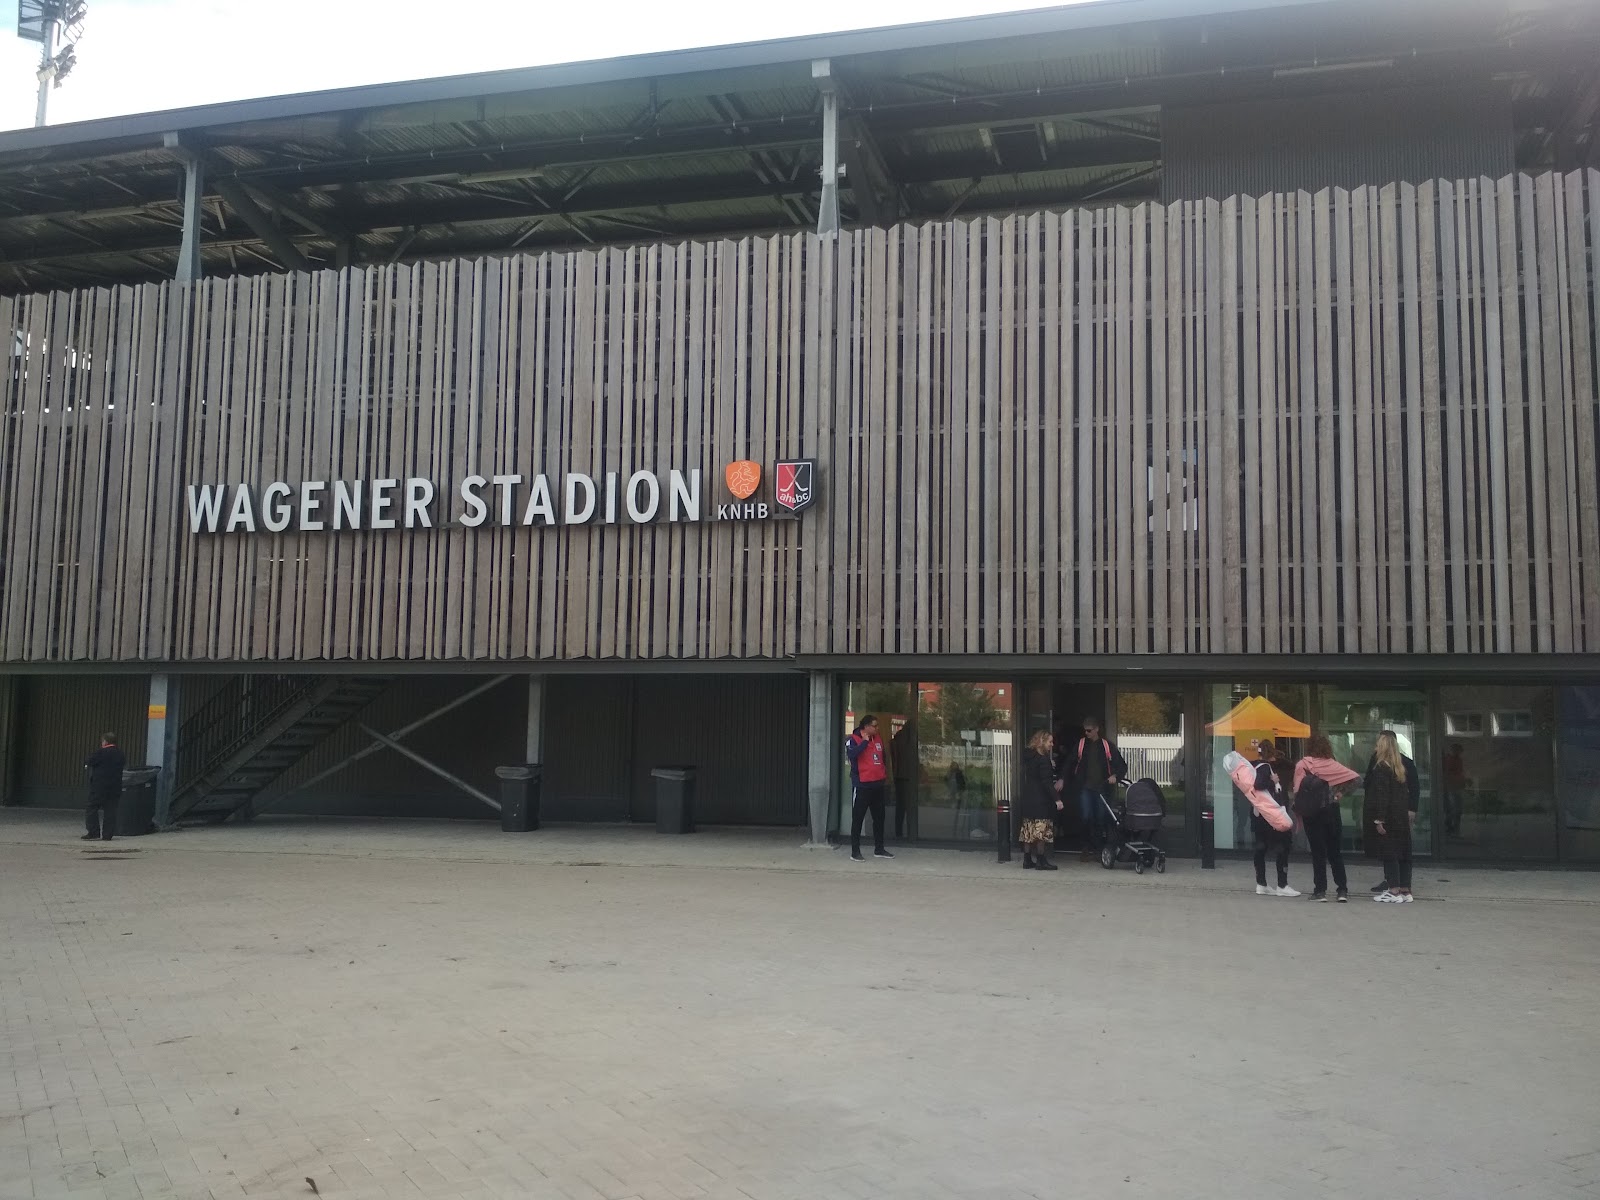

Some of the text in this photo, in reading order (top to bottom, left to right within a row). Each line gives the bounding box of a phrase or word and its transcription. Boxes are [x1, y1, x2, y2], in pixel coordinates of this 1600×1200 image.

[188, 469, 700, 533] WAGENER STADION
[717, 503, 768, 520] KNHB
